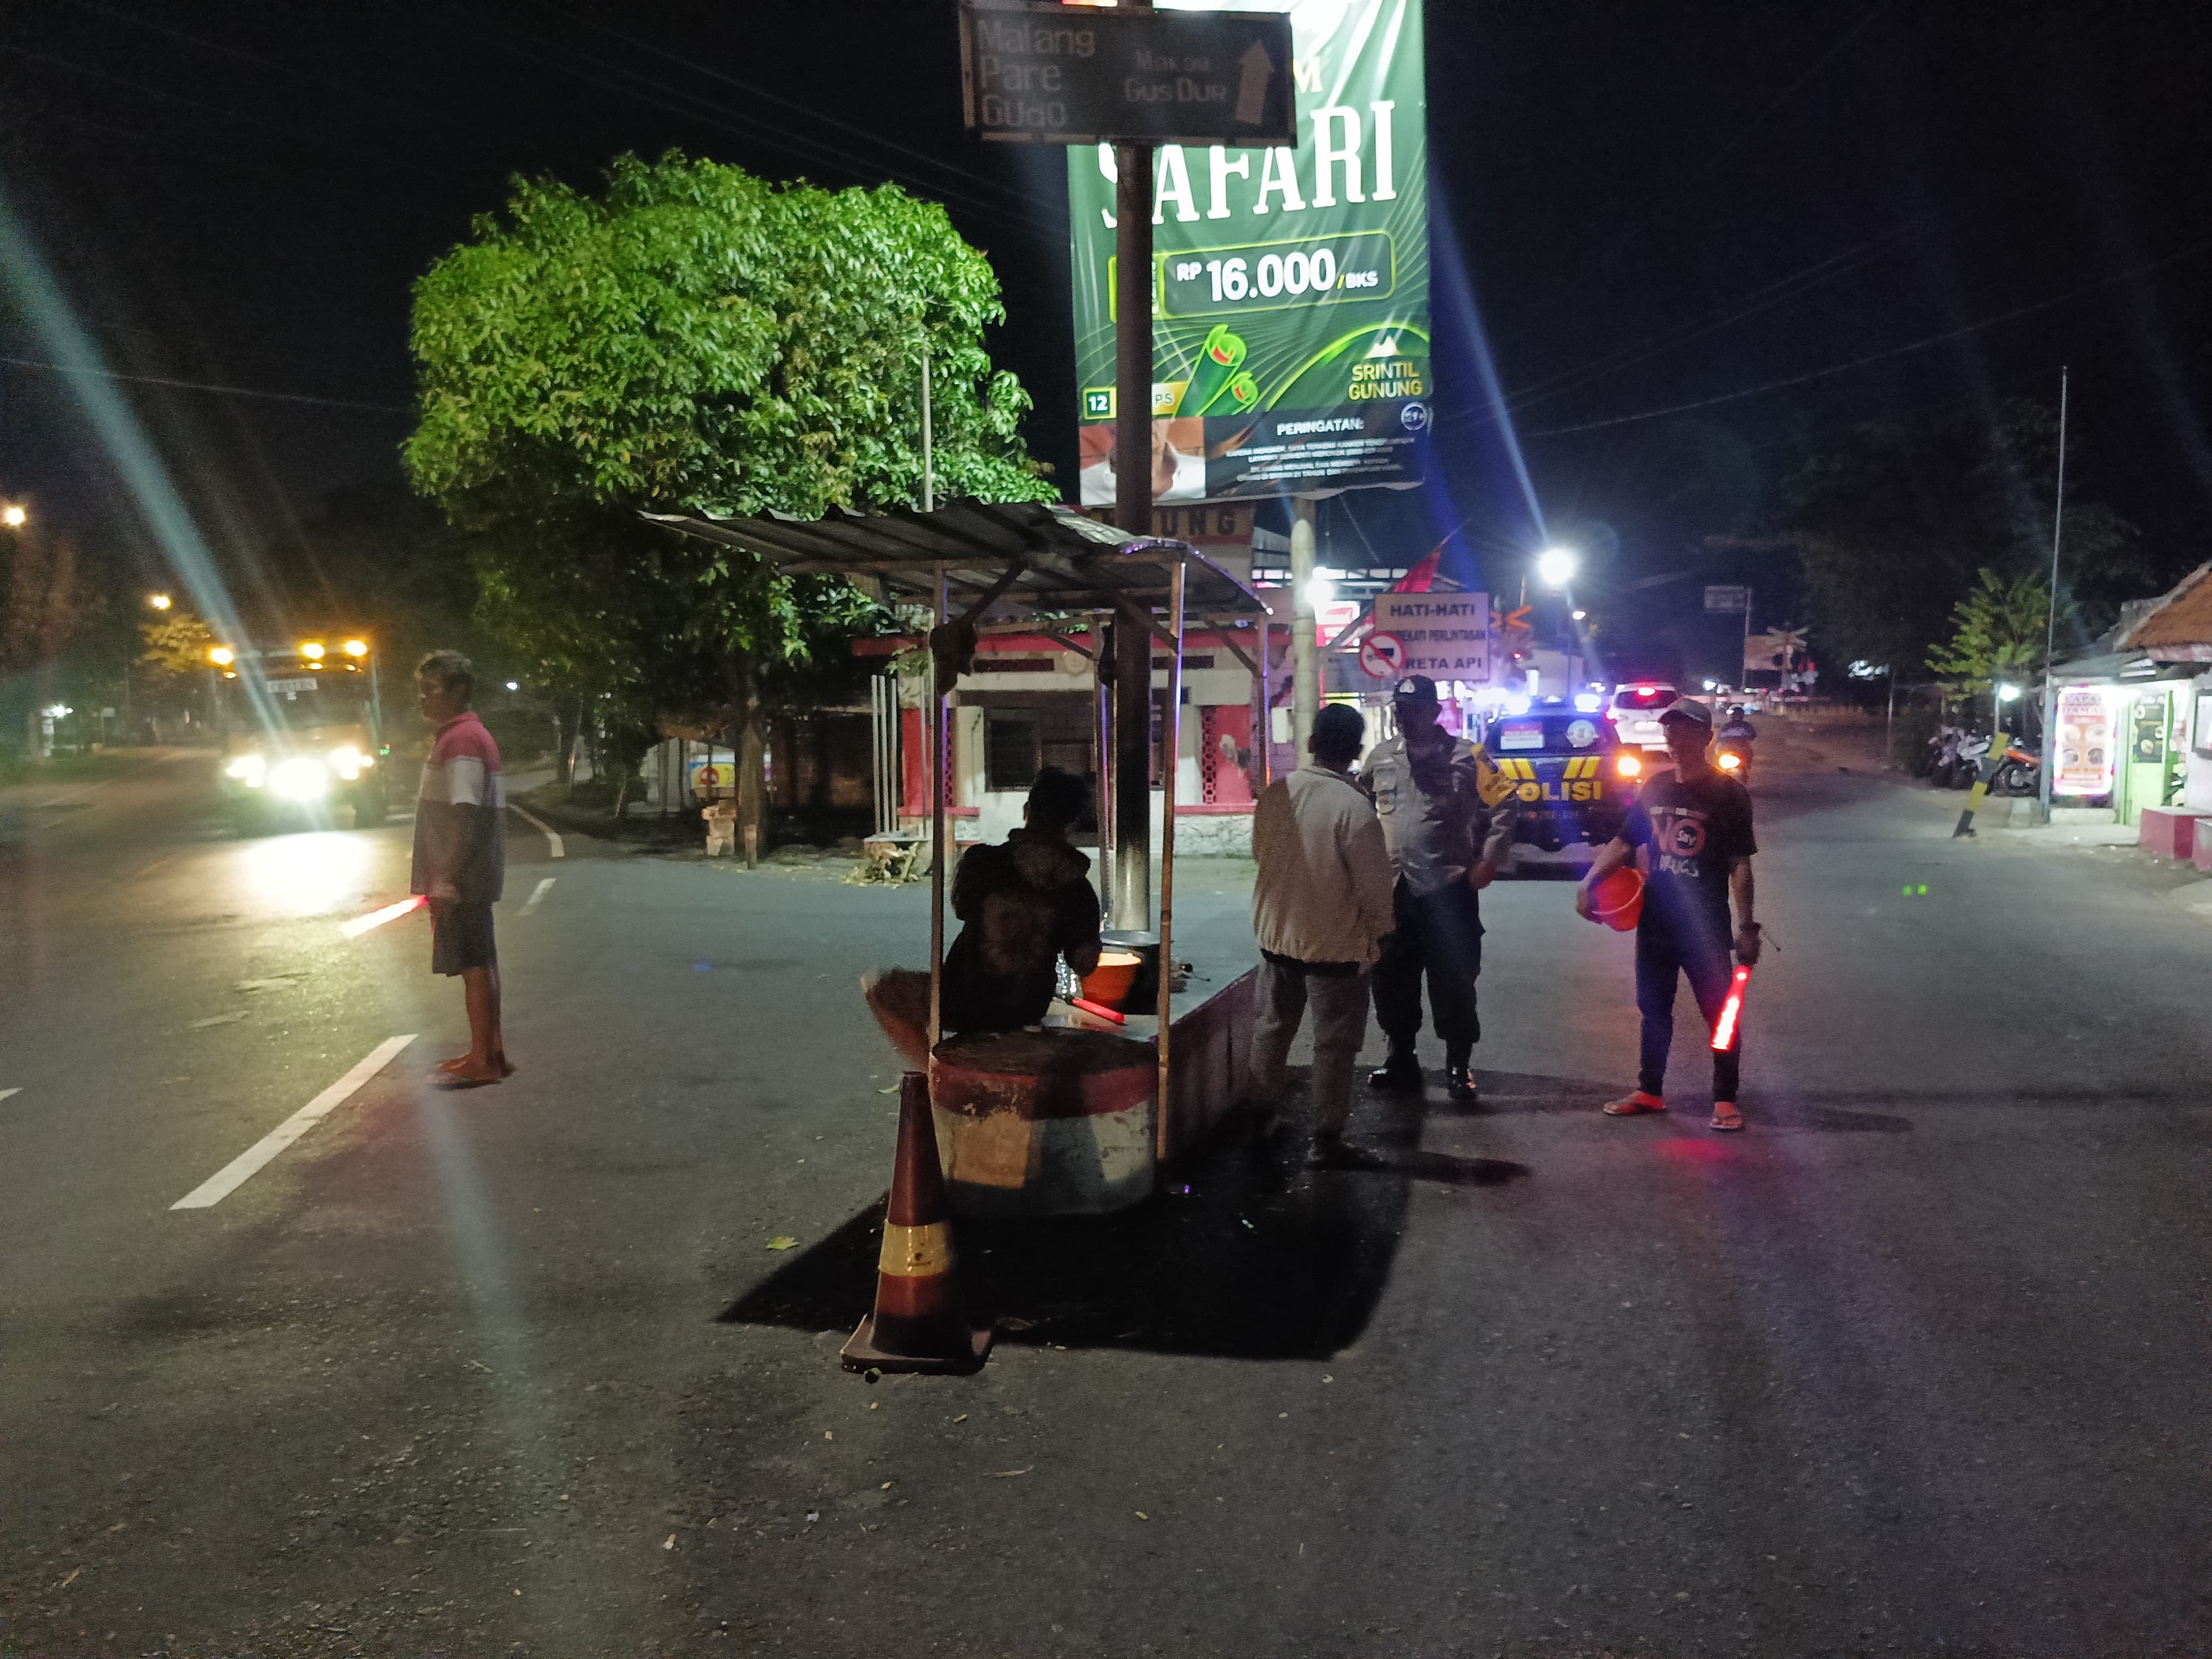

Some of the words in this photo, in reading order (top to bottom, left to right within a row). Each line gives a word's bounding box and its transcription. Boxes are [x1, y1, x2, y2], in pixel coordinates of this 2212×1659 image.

[978, 19, 1095, 57] Malang
[980, 56, 1062, 91] Pare
[1176, 262, 1203, 281] RP
[1352, 362, 1420, 382] SRINTIL
[1348, 379, 1423, 400] GUNUNG
[1088, 395, 1108, 411] 12
[1155, 393, 1175, 405] PS
[1277, 417, 1365, 436] PERINGATAN:
[1161, 504, 1235, 537] UNG
[1390, 603, 1475, 617] HATI-HATI
[1405, 657, 1449, 670] RETA
[1453, 657, 1482, 669] API
[1517, 781, 1602, 802] OLISI
